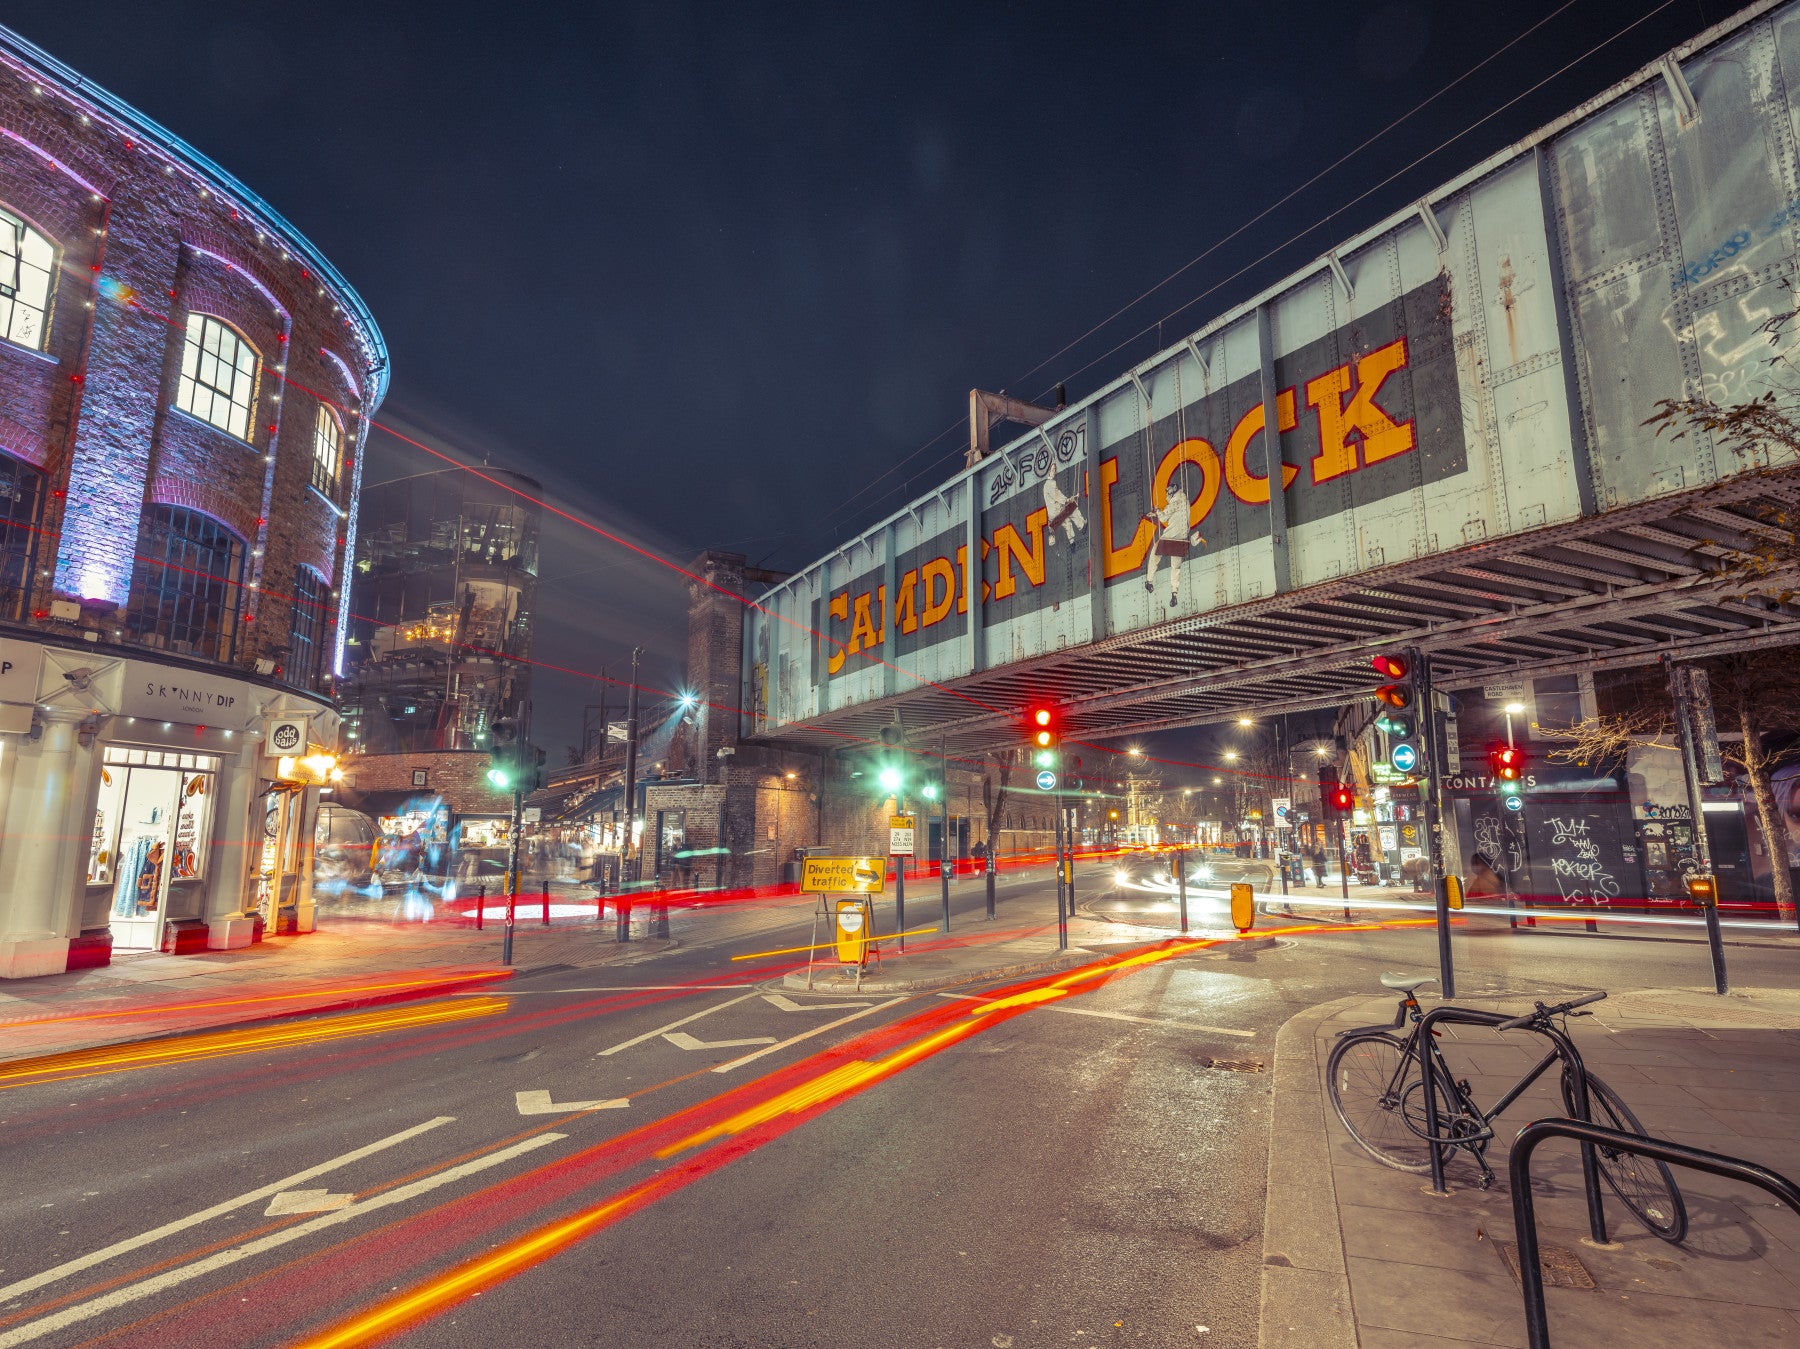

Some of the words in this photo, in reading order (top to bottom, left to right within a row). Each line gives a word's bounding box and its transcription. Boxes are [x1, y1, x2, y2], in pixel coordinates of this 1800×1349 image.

[1085, 336, 1417, 580] LOCK
[1484, 684, 1523, 692] CASTLEHAVEN
[277, 726, 296, 739] odd
[275, 736, 298, 747] balls
[1446, 775, 1536, 789] CONTAS
[808, 863, 854, 875] Diverted
[812, 876, 847, 887] traffic
